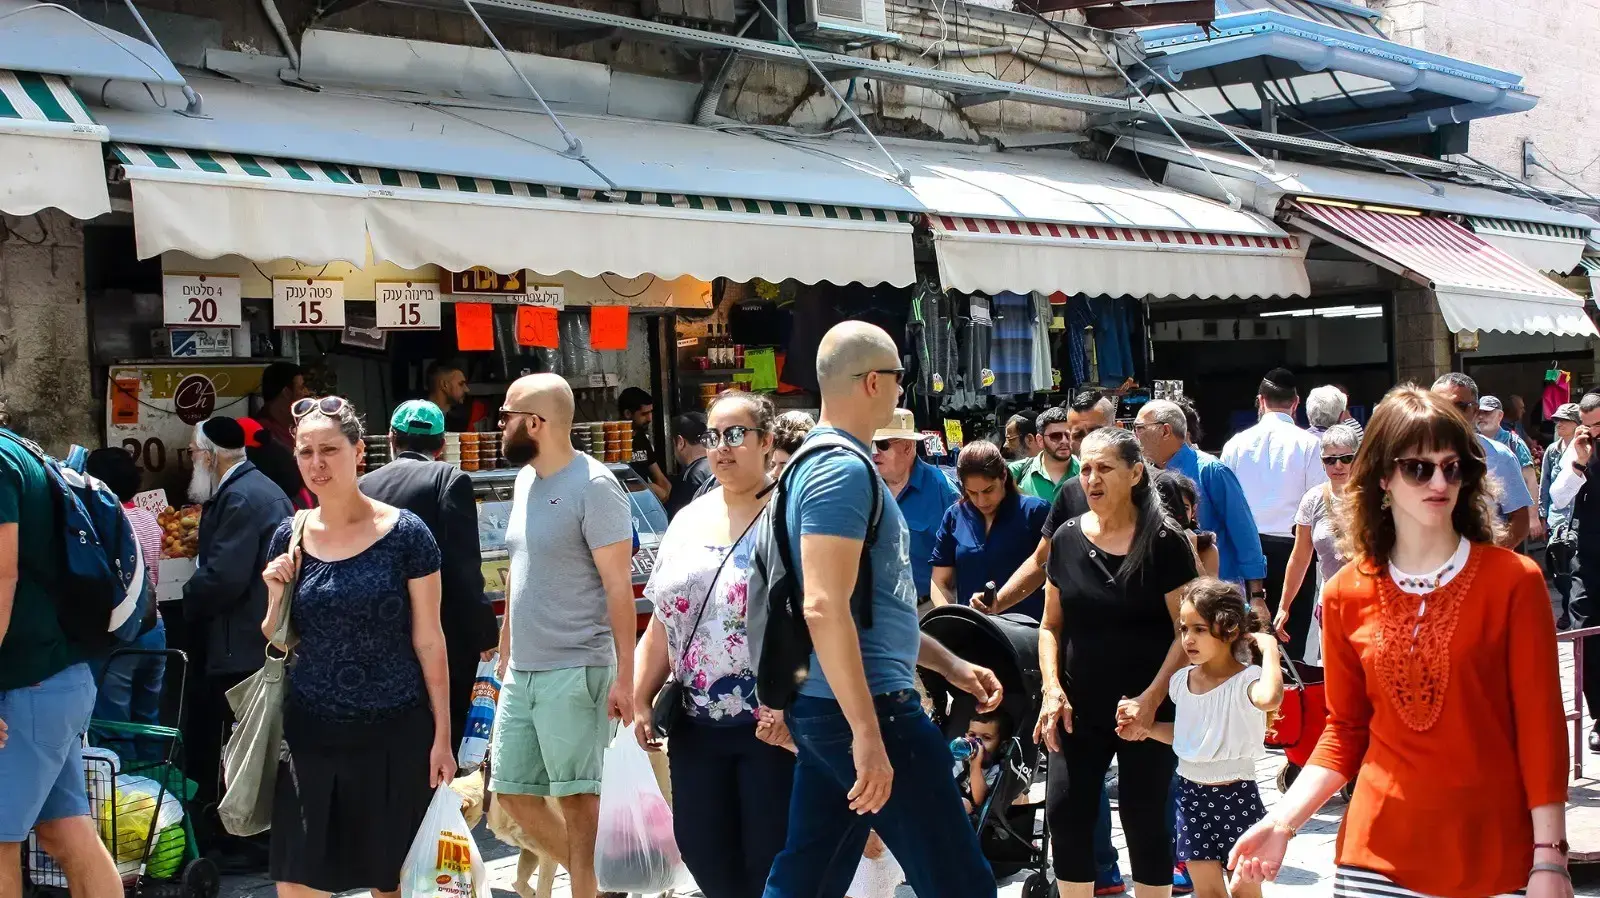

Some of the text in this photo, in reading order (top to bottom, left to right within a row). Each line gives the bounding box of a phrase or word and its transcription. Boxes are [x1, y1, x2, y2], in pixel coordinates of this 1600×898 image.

[182, 283, 223, 296] 4 סלטים
[285, 286, 333, 301] פטה ענק
[382, 289, 402, 303] ענק
[187, 297, 218, 323] 20
[298, 300, 323, 325] 15
[398, 302, 421, 325] 15
[122, 437, 166, 473] 20
